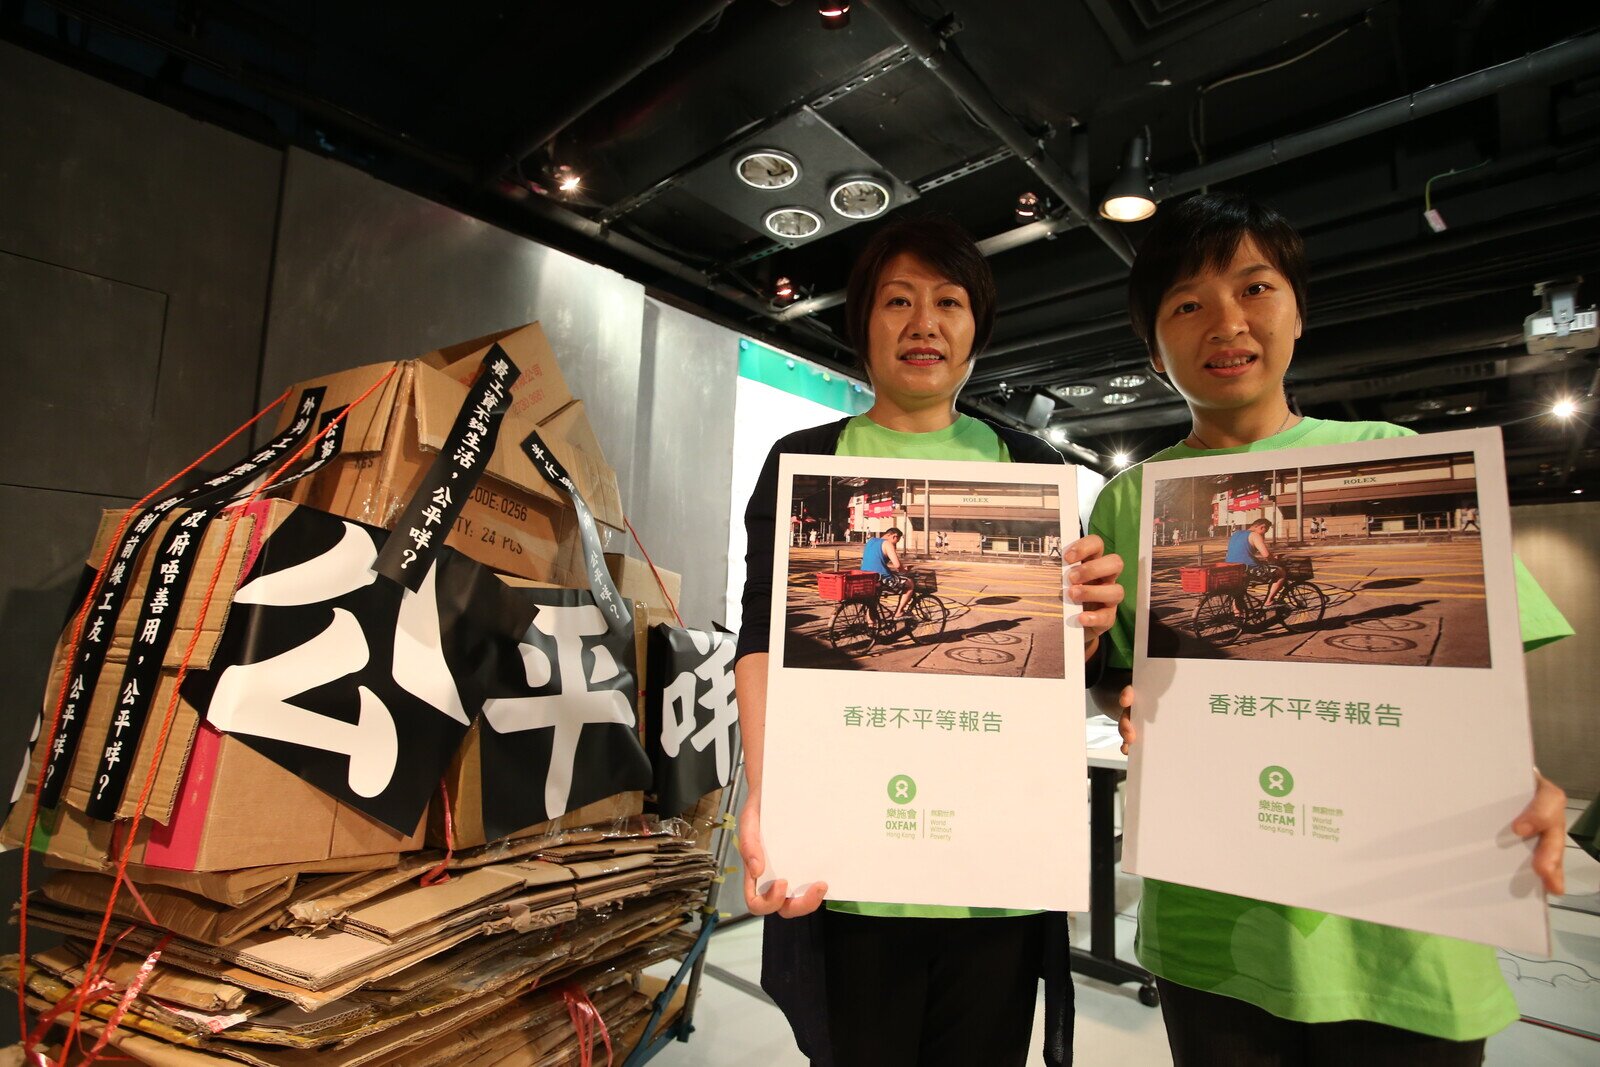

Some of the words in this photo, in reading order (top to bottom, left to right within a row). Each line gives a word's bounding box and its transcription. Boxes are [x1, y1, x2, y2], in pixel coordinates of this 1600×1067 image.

[1343, 476, 1377, 485] ROLEX
[456, 516, 473, 538] TY:
[481, 526, 497, 546] 24
[1208, 693, 1403, 728] 香港不平等報告
[843, 706, 1003, 733] 香港不平等報告
[886, 808, 917, 819] 樂施會
[1258, 799, 1295, 814] 樂施會
[885, 820, 917, 831] OXFAM
[1257, 812, 1296, 827] OXFAM
[886, 831, 901, 839] Hong
[901, 832, 916, 840] Kong
[1260, 823, 1277, 833] Hong
[1277, 827, 1294, 836] Kong
